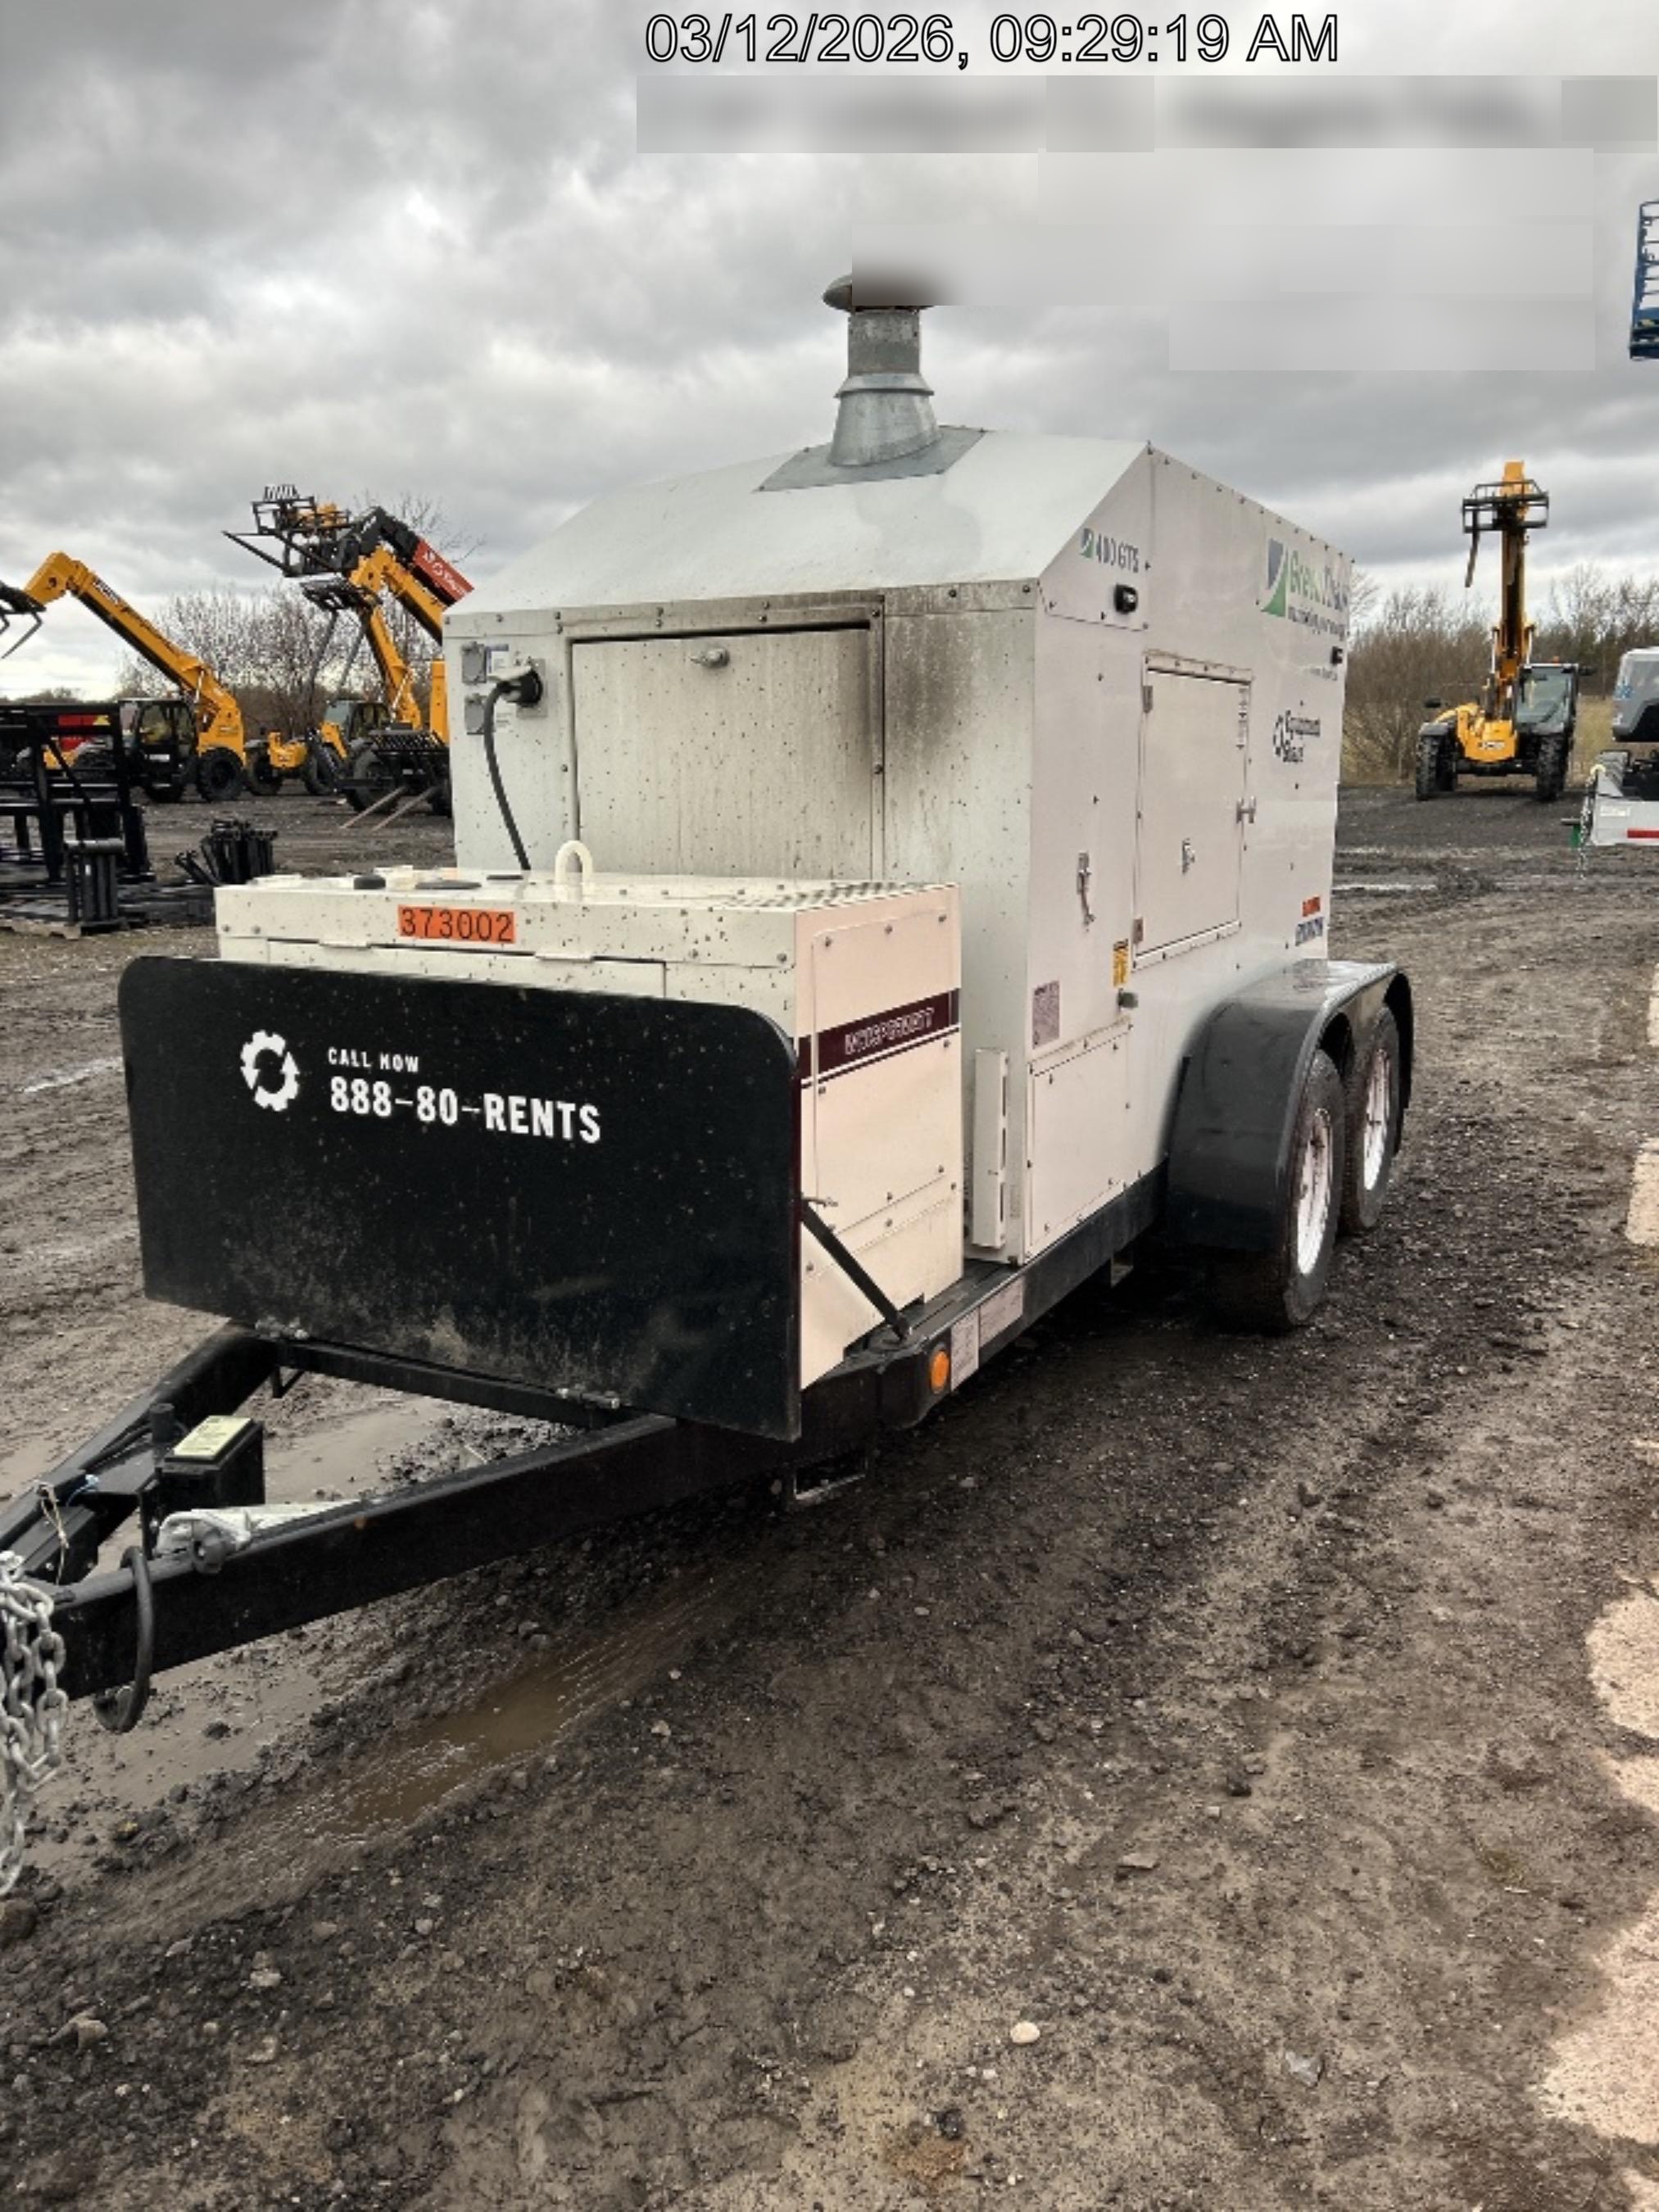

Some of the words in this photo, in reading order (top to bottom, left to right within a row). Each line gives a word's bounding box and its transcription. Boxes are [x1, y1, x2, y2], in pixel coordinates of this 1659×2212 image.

[401, 907, 512, 942] 373002
[328, 1047, 371, 1067] CALL
[379, 1052, 419, 1073] NOW
[330, 1076, 601, 1144] 888-80-RENTS
